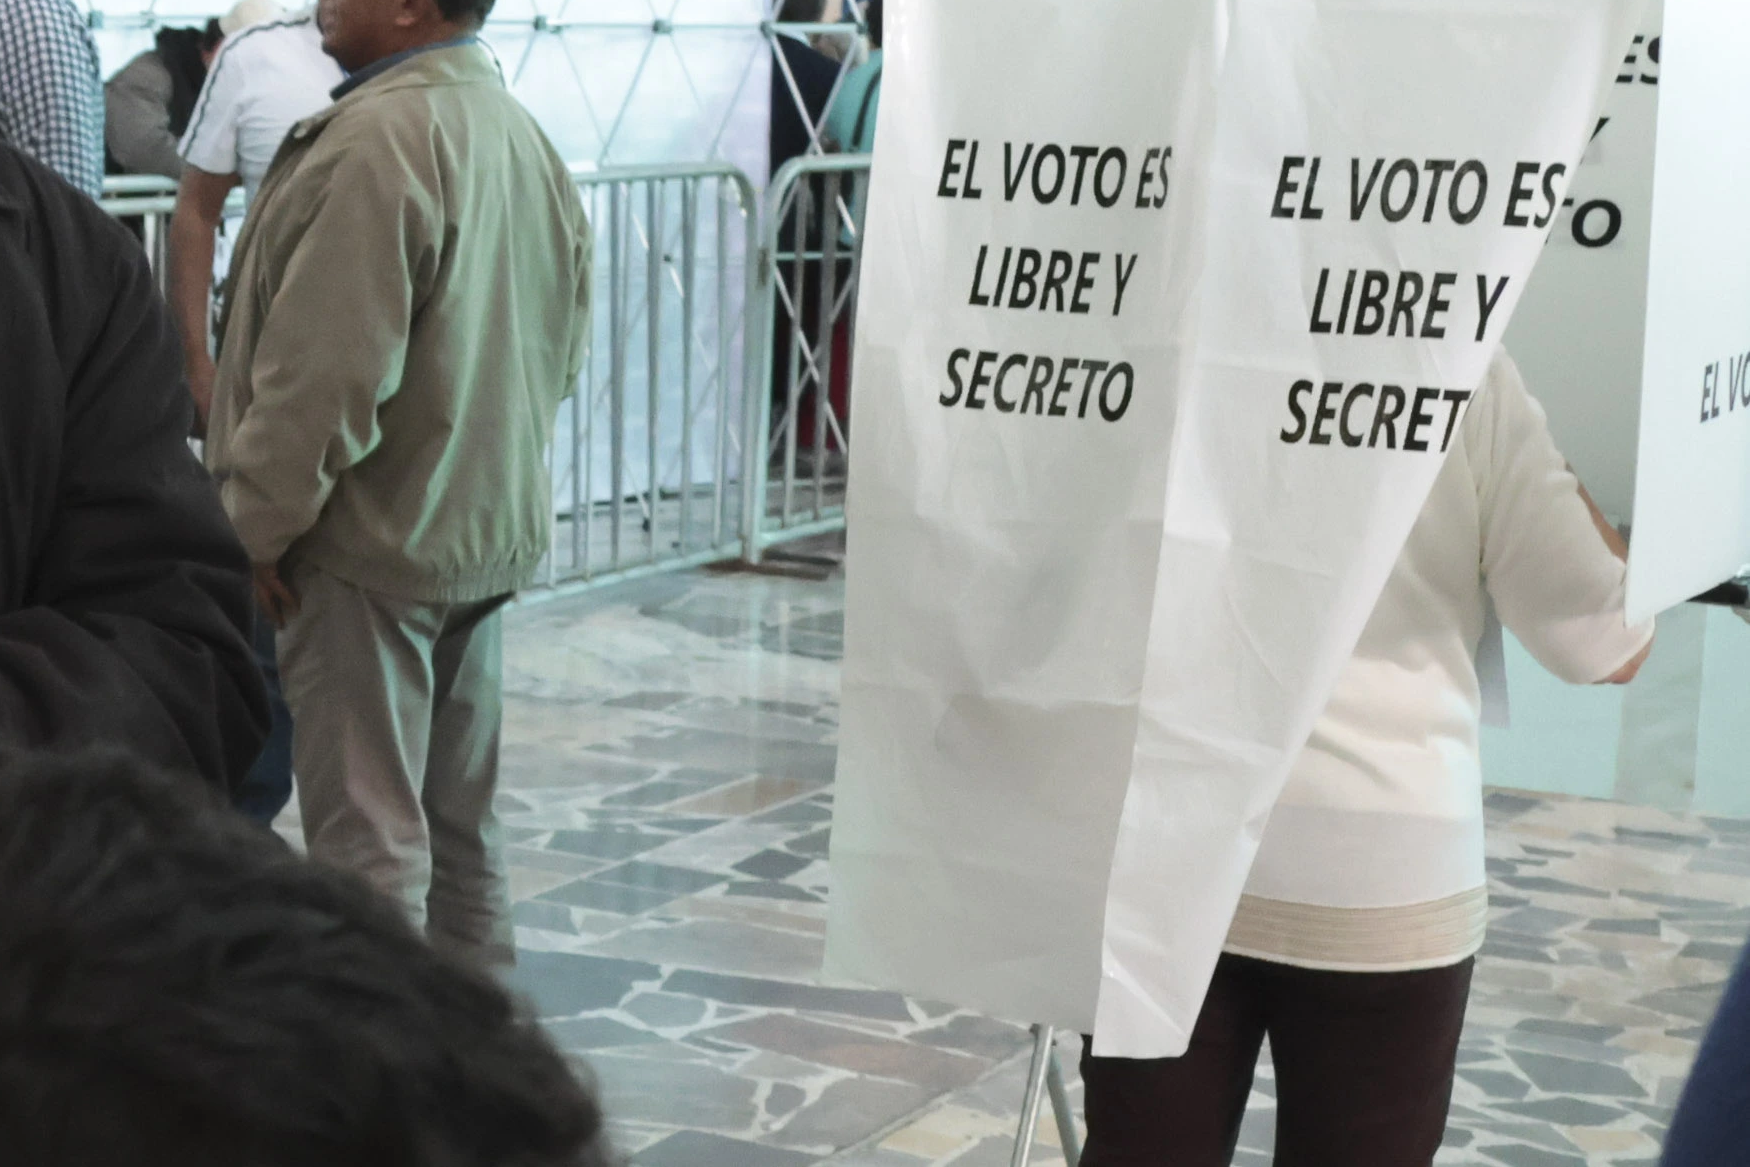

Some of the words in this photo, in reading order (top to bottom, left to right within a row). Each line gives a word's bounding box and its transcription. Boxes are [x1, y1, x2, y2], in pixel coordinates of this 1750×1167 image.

[937, 138, 982, 199] EL
[1003, 141, 1127, 209] VOTO
[1135, 145, 1172, 210] ES
[1270, 156, 1324, 220] EL
[1350, 158, 1488, 225] VOTO
[1502, 162, 1567, 229] ES
[968, 244, 1100, 314] LIBRE
[1112, 252, 1139, 317] Y
[1309, 267, 1458, 339] LIBRE
[1474, 274, 1510, 342] Y
[938, 347, 1134, 422] SECRETO
[1700, 361, 1721, 424] EL
